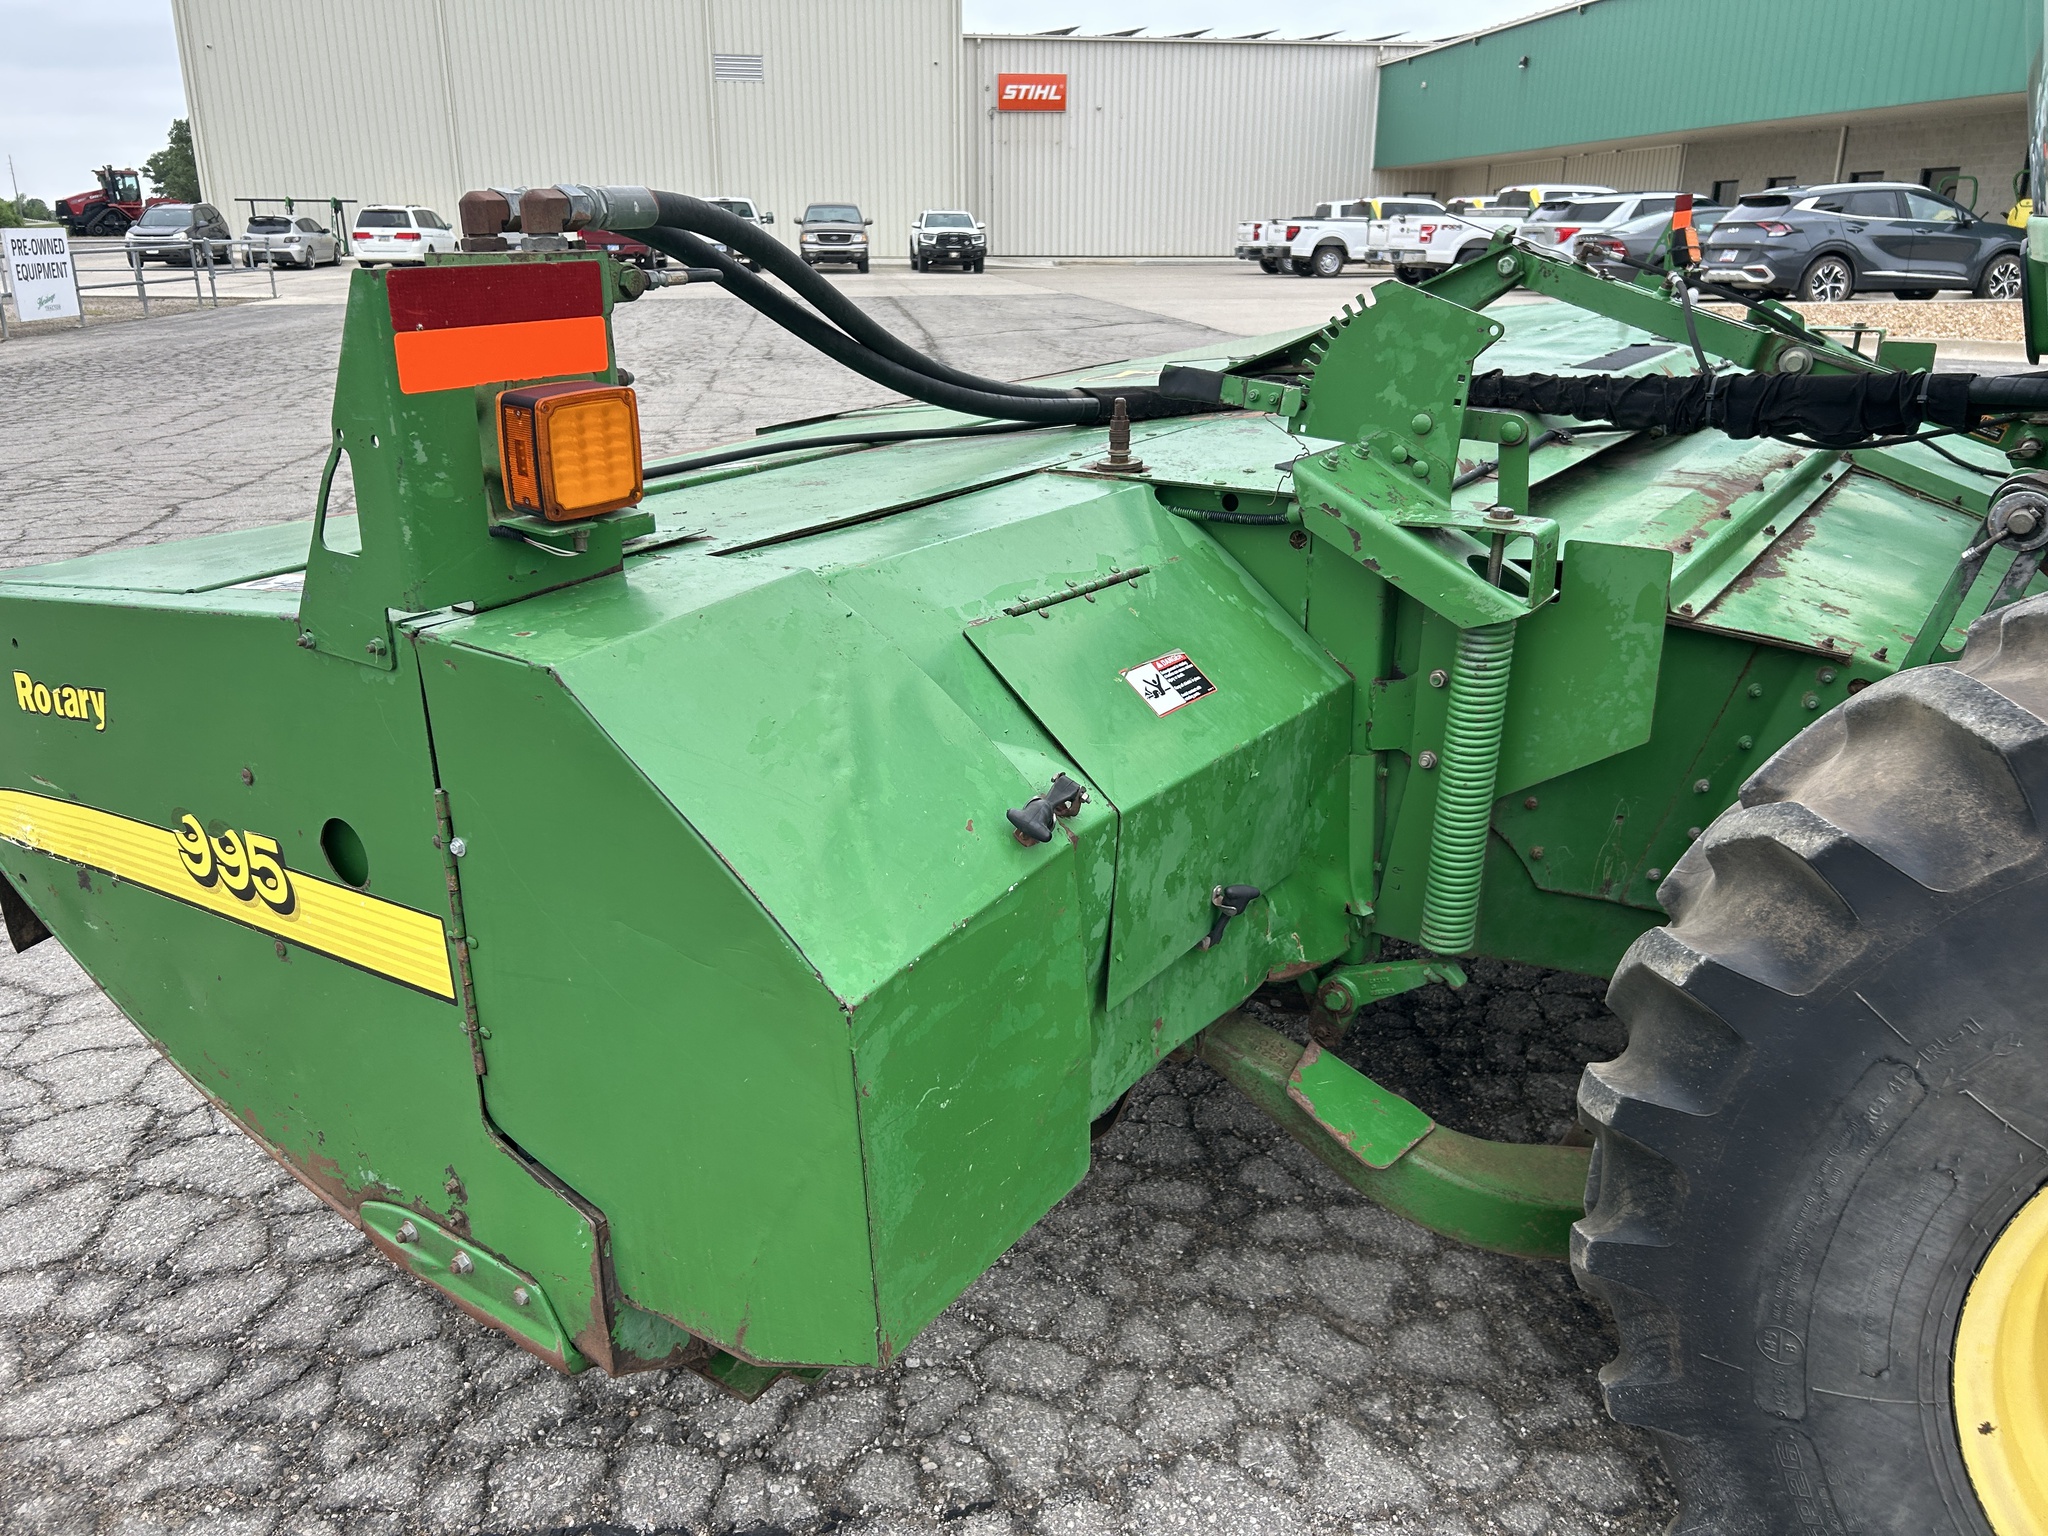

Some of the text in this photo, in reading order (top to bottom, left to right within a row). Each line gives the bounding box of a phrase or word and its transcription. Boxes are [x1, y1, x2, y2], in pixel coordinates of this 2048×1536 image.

[1002, 84, 1062, 100] STIHL
[11, 238, 65, 256] PRE-OWNED
[16, 262, 68, 282] EQUIPMENT
[12, 669, 107, 734] Rotary
[173, 810, 297, 916] 995
